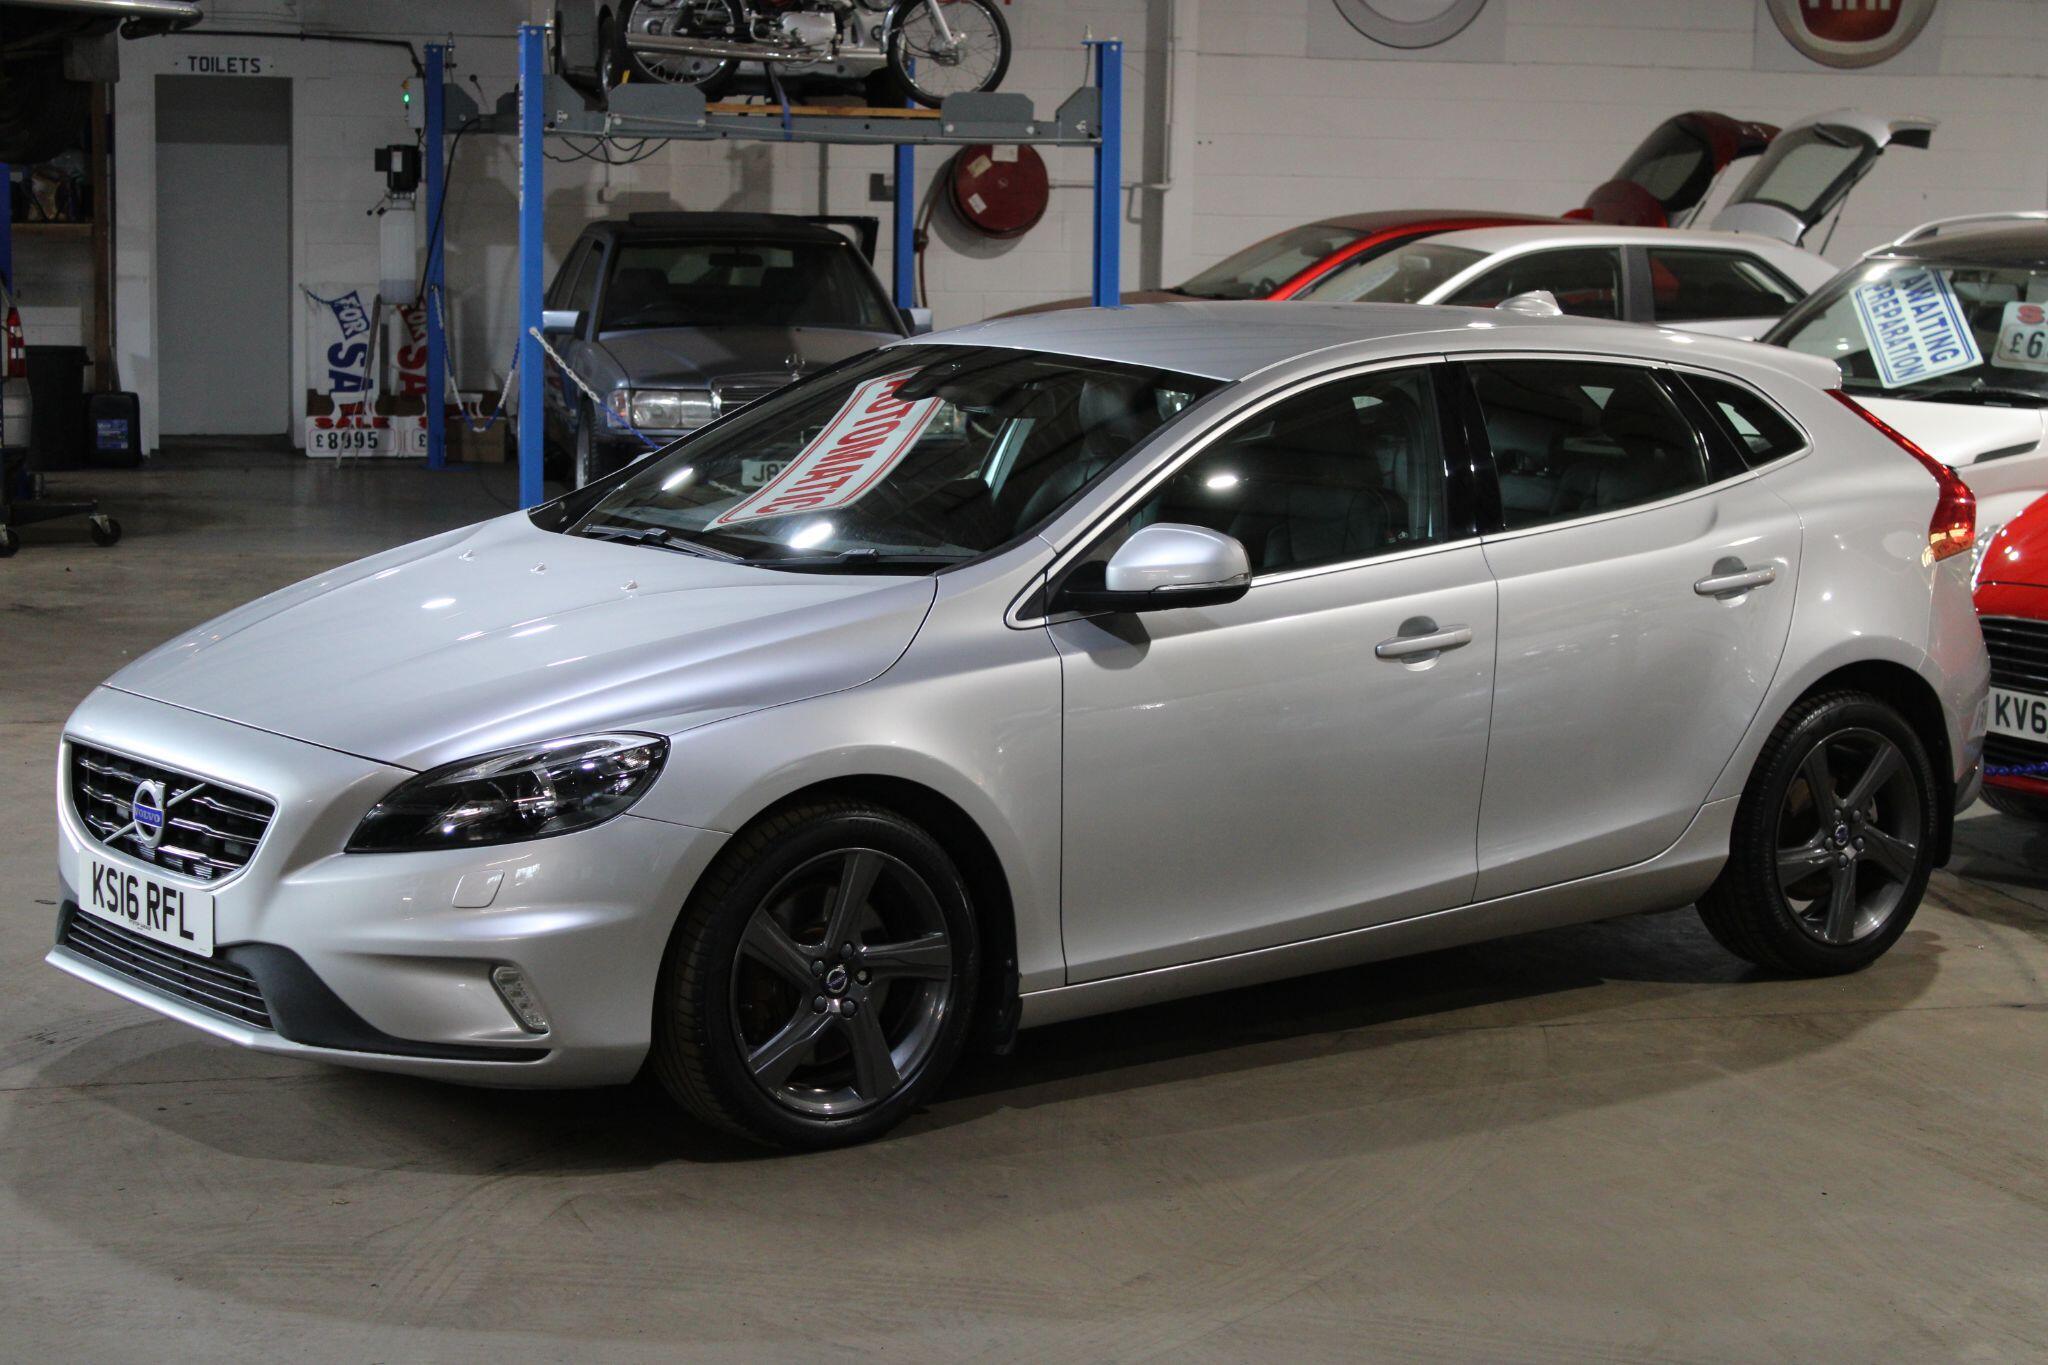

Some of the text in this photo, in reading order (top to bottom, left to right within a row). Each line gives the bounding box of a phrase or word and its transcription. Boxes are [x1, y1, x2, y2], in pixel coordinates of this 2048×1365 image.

[187, 56, 261, 73] TOILETS
[331, 292, 370, 337] FOR
[1865, 280, 1927, 379] PREPARATION
[1901, 273, 1960, 364] AWAITING
[327, 342, 373, 394] SA
[135, 807, 160, 823] VOLVO
[93, 861, 194, 941] KS16 RFL
